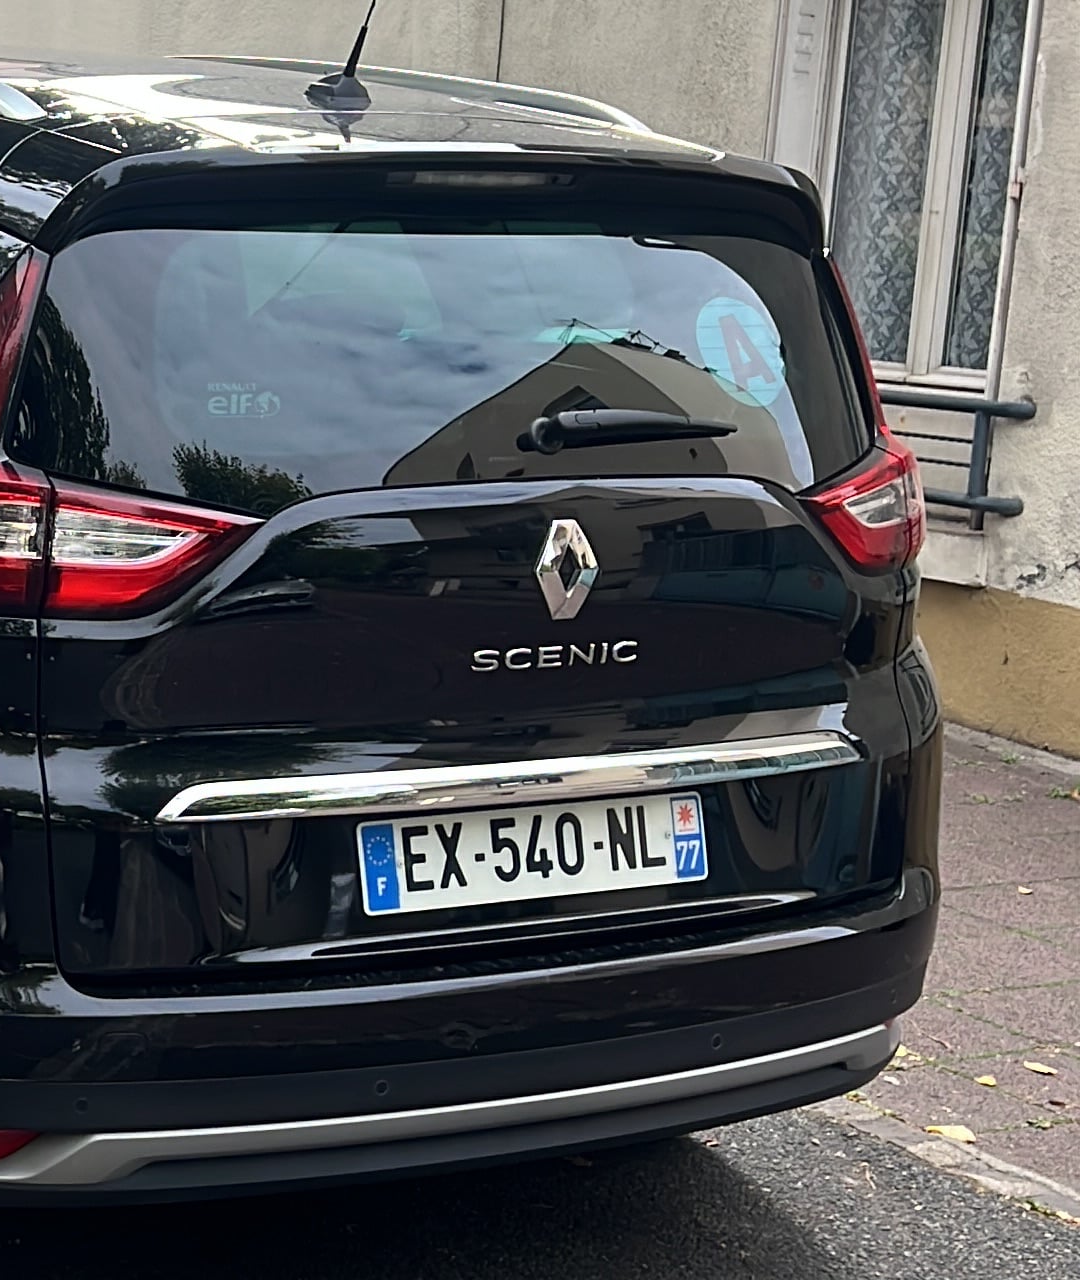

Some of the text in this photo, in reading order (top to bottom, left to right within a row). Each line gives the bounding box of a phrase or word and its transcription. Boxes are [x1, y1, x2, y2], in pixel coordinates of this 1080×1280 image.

[718, 314, 778, 393] A
[207, 383, 256, 391] RENAULT
[207, 393, 253, 414] elf
[471, 640, 638, 671] SCENIC
[376, 805, 700, 897] F EX-540-NL 77
